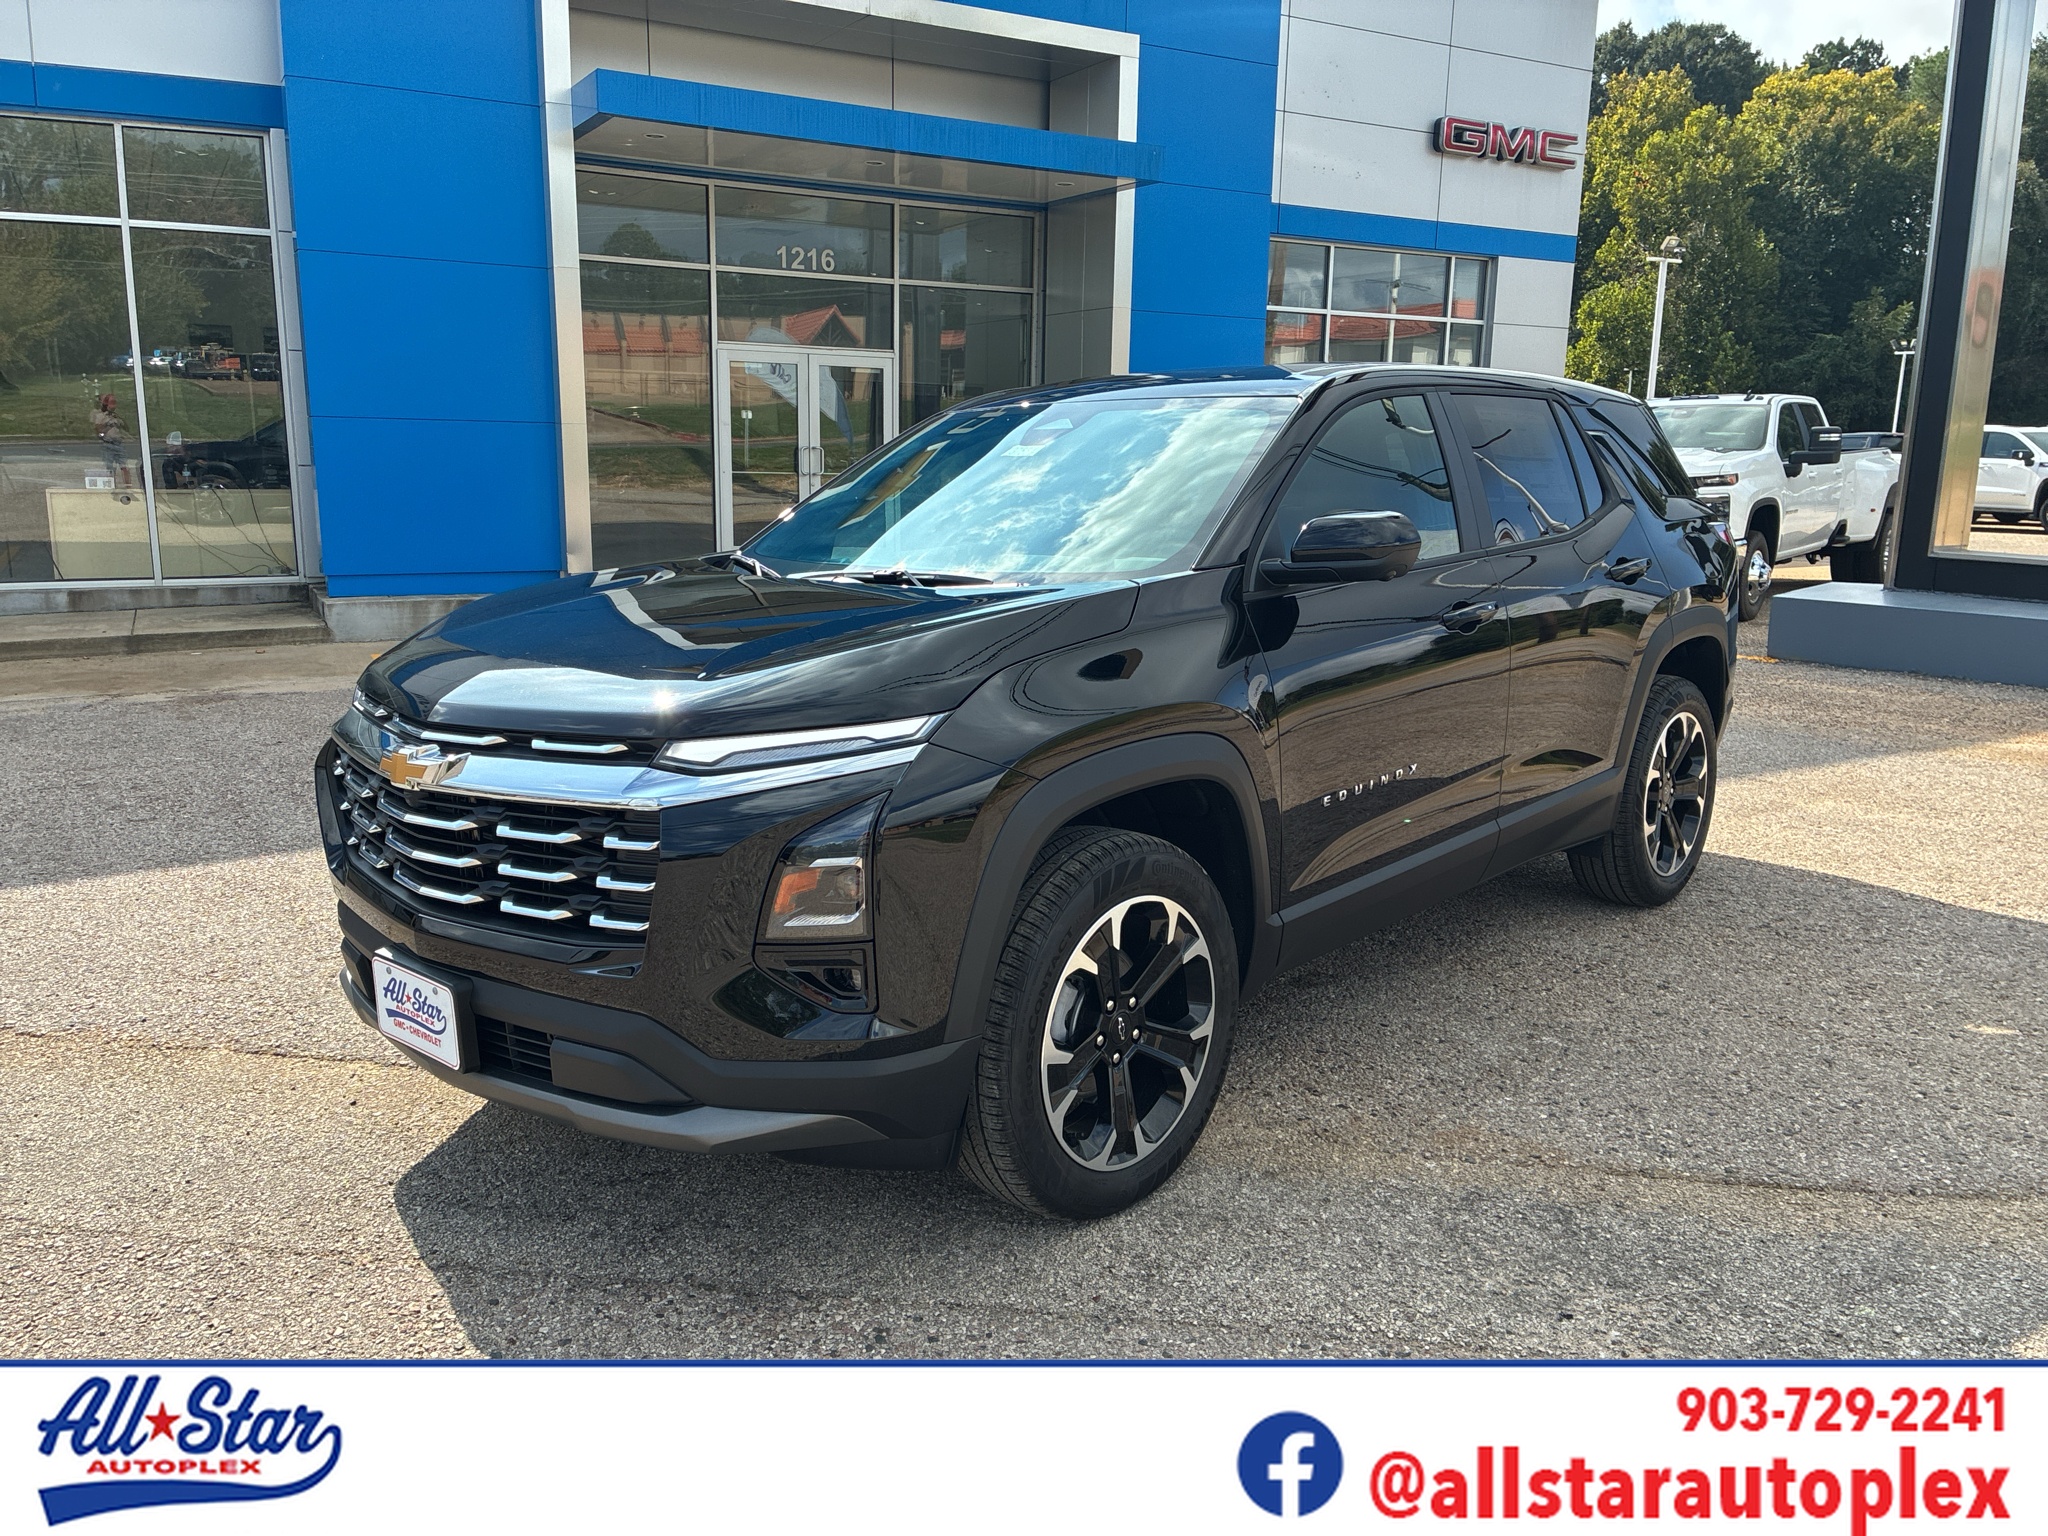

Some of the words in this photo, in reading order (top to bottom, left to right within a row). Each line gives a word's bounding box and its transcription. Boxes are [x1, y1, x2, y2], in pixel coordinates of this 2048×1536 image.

[1433, 115, 1579, 170] GMC
[776, 245, 835, 272] 1216
[1322, 763, 1418, 808] EQUINOX
[396, 1005, 436, 1027] AUTOPLEX
